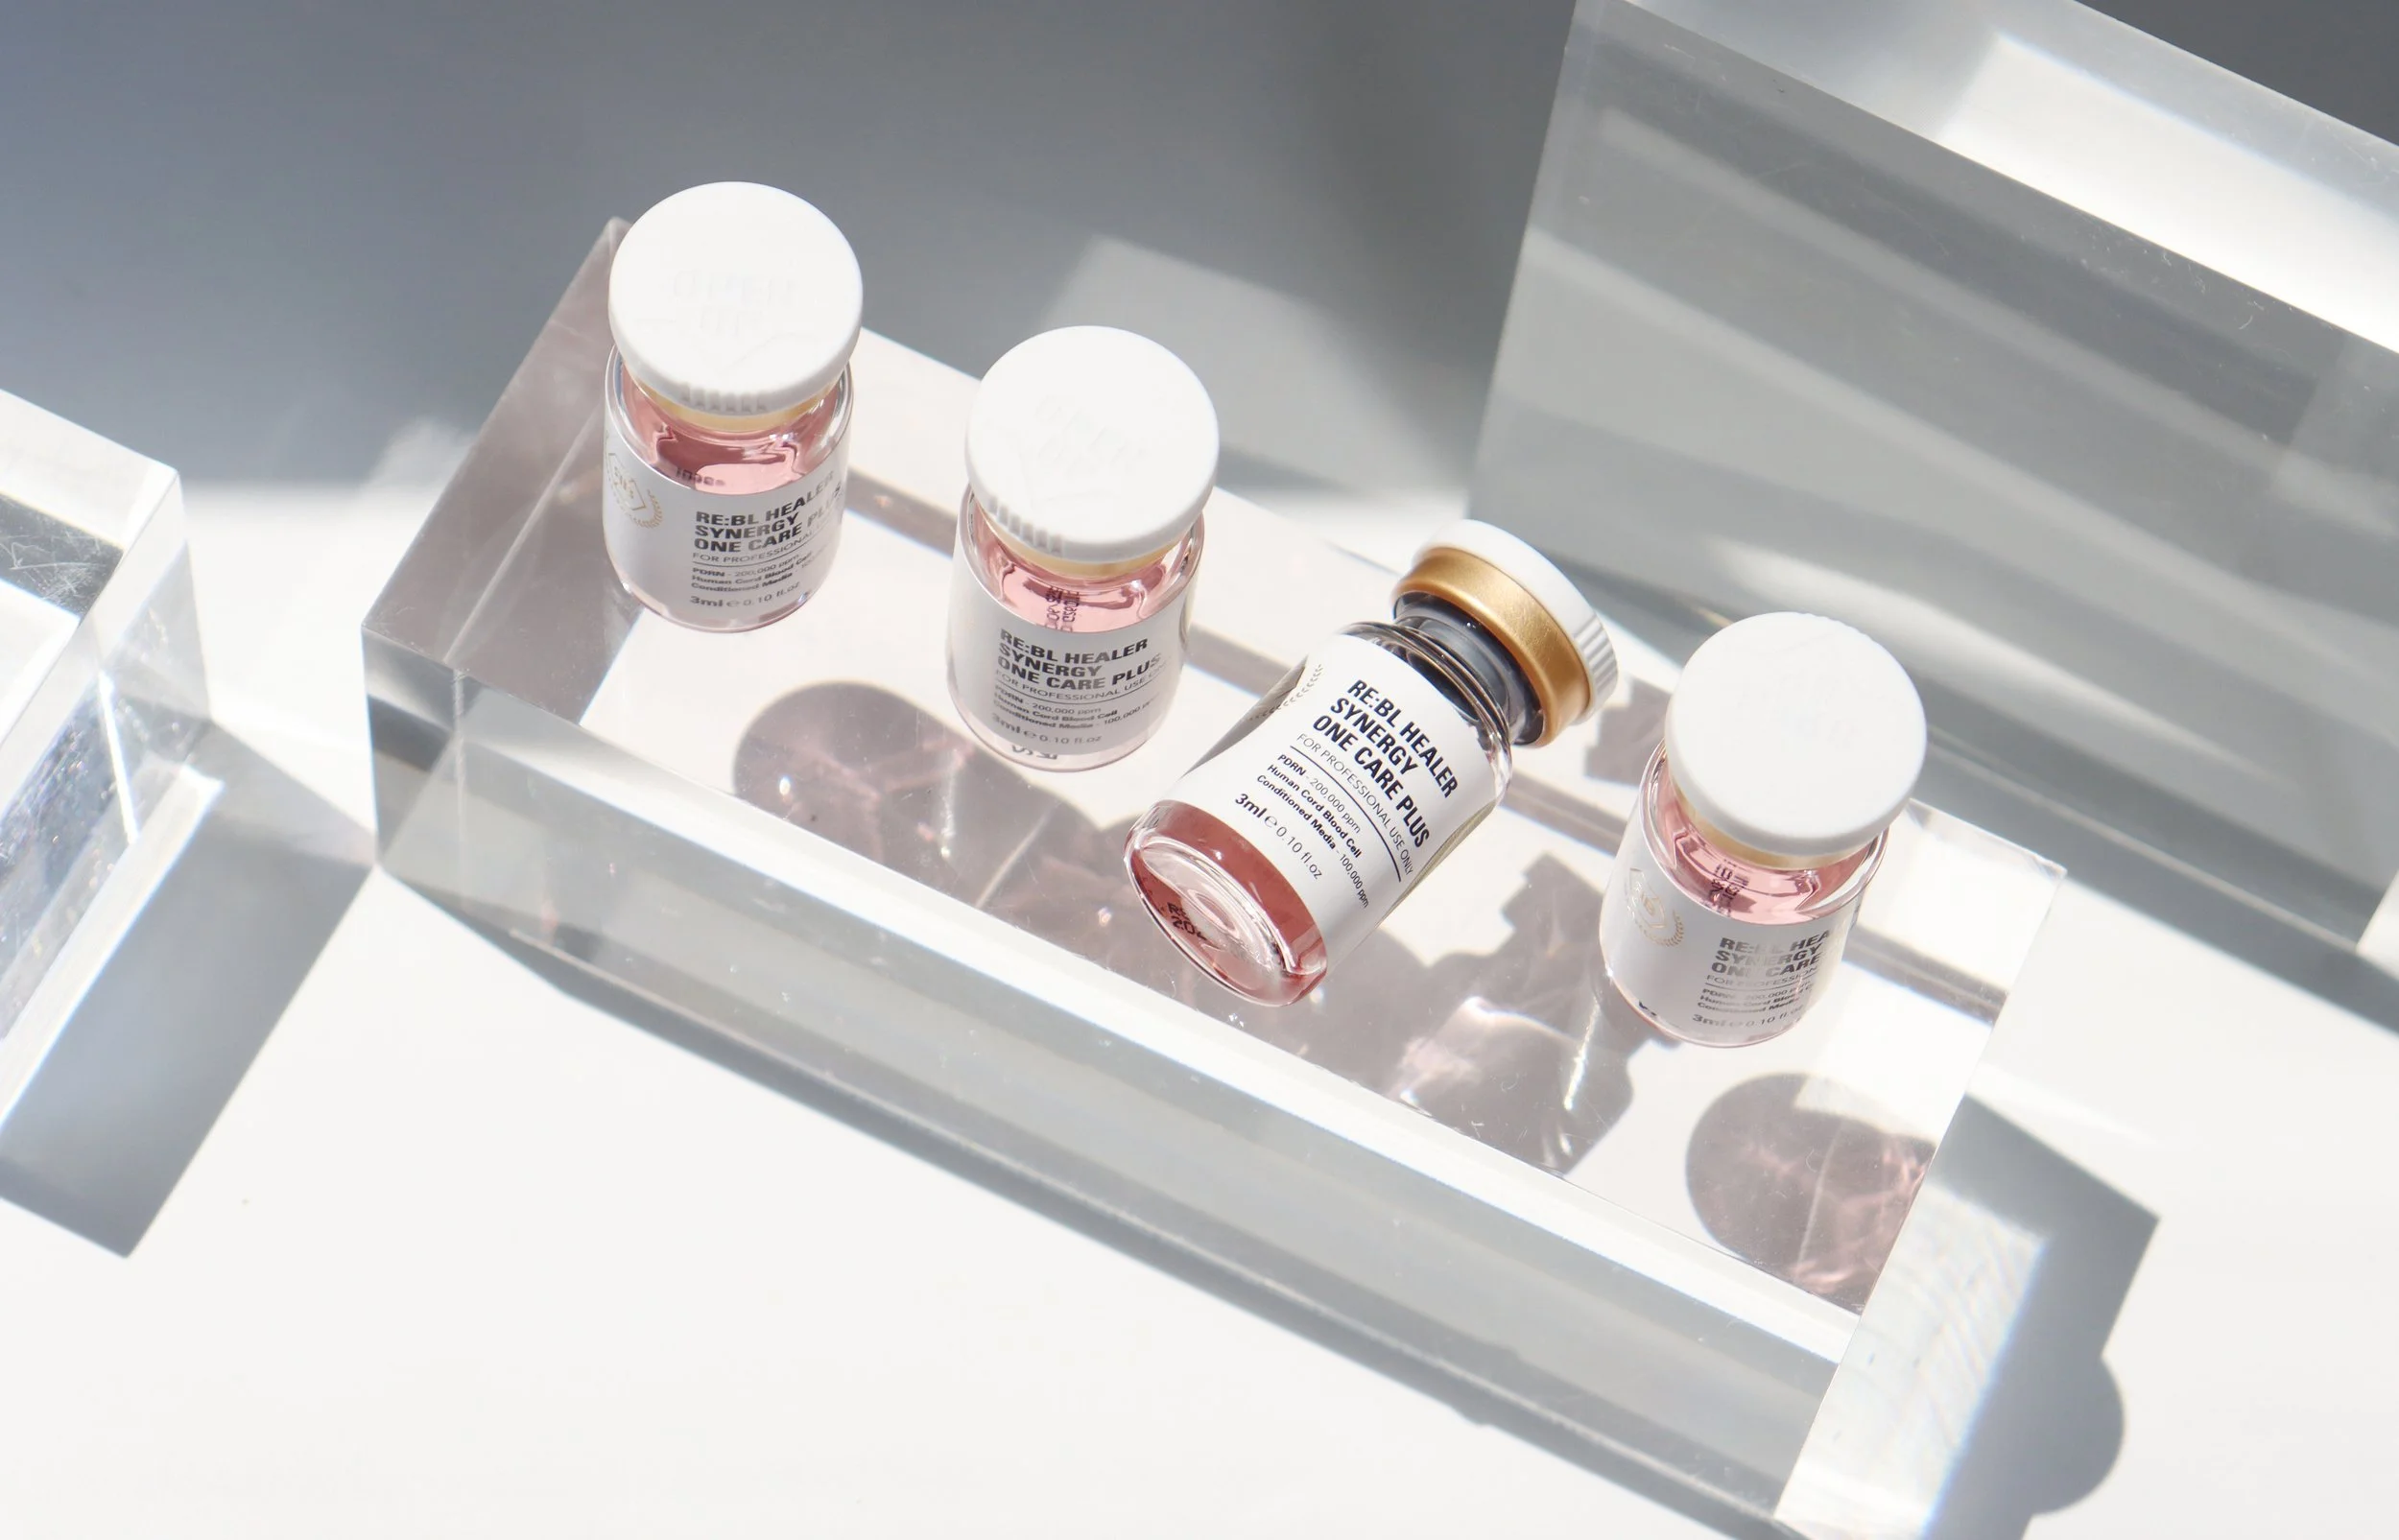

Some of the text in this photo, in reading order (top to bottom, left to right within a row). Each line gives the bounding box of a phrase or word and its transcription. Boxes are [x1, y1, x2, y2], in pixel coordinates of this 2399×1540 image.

[695, 511, 798, 539] SYNERGY
[696, 510, 759, 527] RE:BL
[694, 538, 742, 553] ONE
[748, 523, 802, 552] CARE
[692, 567, 725, 578] PDRN
[693, 552, 720, 563] FOR
[692, 576, 731, 585] Human
[690, 596, 724, 607] 3ml
[999, 642, 1102, 677] SYNERGY
[1001, 628, 1148, 664] RE:BL HEALER
[997, 656, 1039, 684] ONE
[1046, 676, 1105, 691] CARE
[1112, 653, 1161, 686] PLUS
[1022, 684, 1120, 700] PROFESSIONAL
[1124, 676, 1146, 691] USE
[1330, 698, 1418, 775] SYNERGY
[1346, 679, 1458, 798] RE:BL HEALER
[1277, 754, 1307, 777] PDRN
[1309, 777, 1345, 813] 200,000
[1342, 812, 1361, 835] ppm
[1313, 715, 1430, 848] ONE CARE PLUS
[1267, 764, 1362, 858] Human Cord Blood Cell
[1296, 733, 1413, 876] FOR PROFESSIONAL USE ONLY
[1234, 793, 1268, 819] 3ml
[1276, 826, 1303, 854] 0.10
[1301, 851, 1323, 880] fl.oz
[1257, 774, 1313, 822] Conditioned
[1310, 818, 1337, 850] Media
[1340, 853, 1364, 889] 100,000
[1357, 888, 1369, 910] ppm
[1711, 951, 1822, 978] ON CARE
